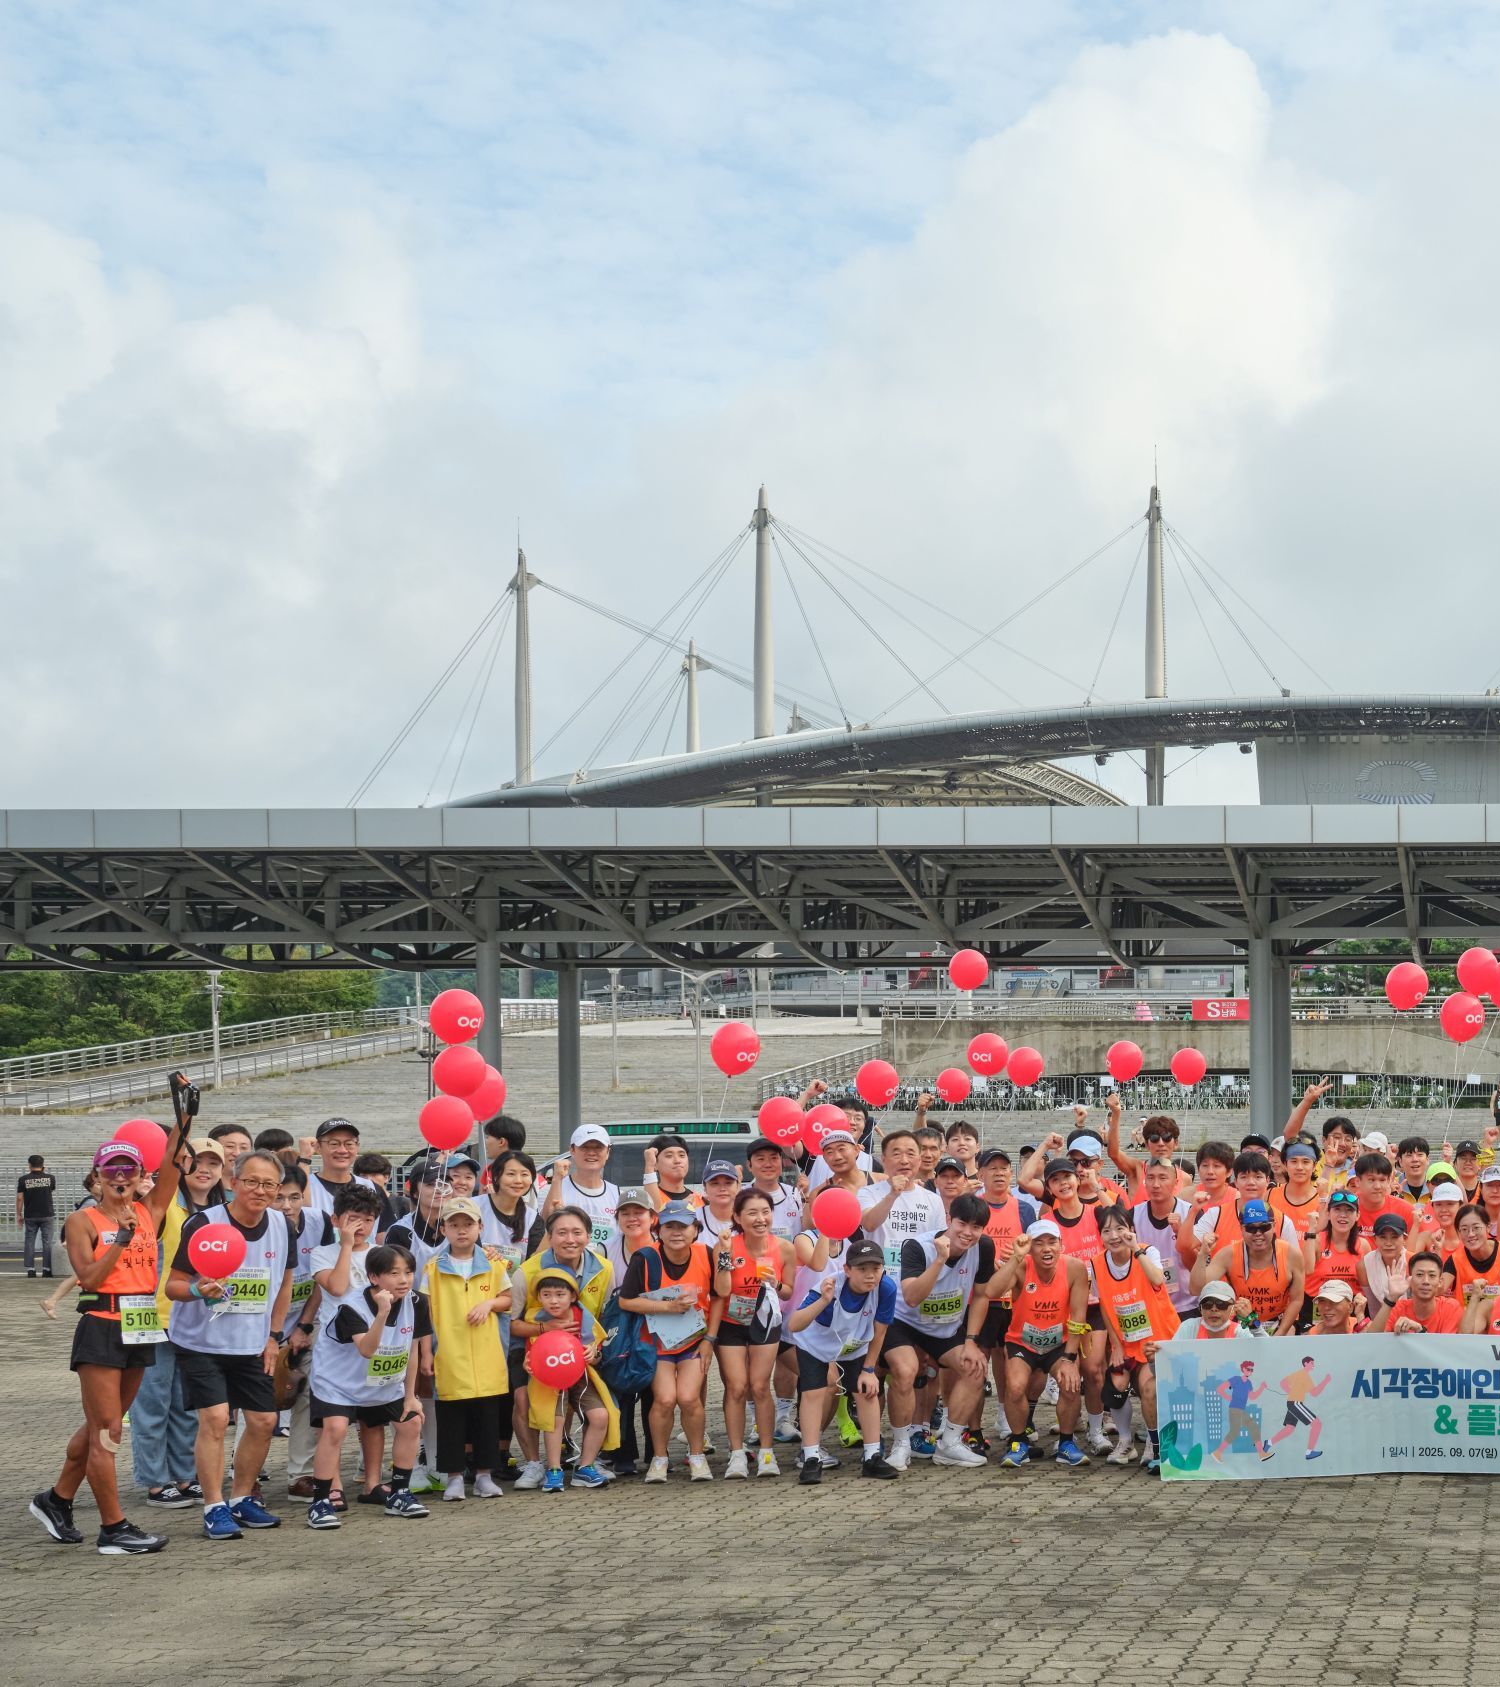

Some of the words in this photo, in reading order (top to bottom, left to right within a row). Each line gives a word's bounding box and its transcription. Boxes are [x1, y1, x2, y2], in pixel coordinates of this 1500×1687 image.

[892, 1221, 918, 1233] 마라톤
[986, 1226, 1011, 1236] VMK
[1331, 1266, 1351, 1274] VMK
[1248, 1287, 1270, 1295] VMK
[923, 1299, 962, 1313] 50458
[1034, 1300, 1060, 1309] VMK
[1028, 1334, 1058, 1347] 1324
[1434, 1404, 1459, 1434] &
[1389, 1446, 1408, 1458] 일시
[1418, 1447, 1446, 1458] 2025.
[1450, 1447, 1465, 1458] 09.
[1468, 1447, 1498, 1459] 07(일)
